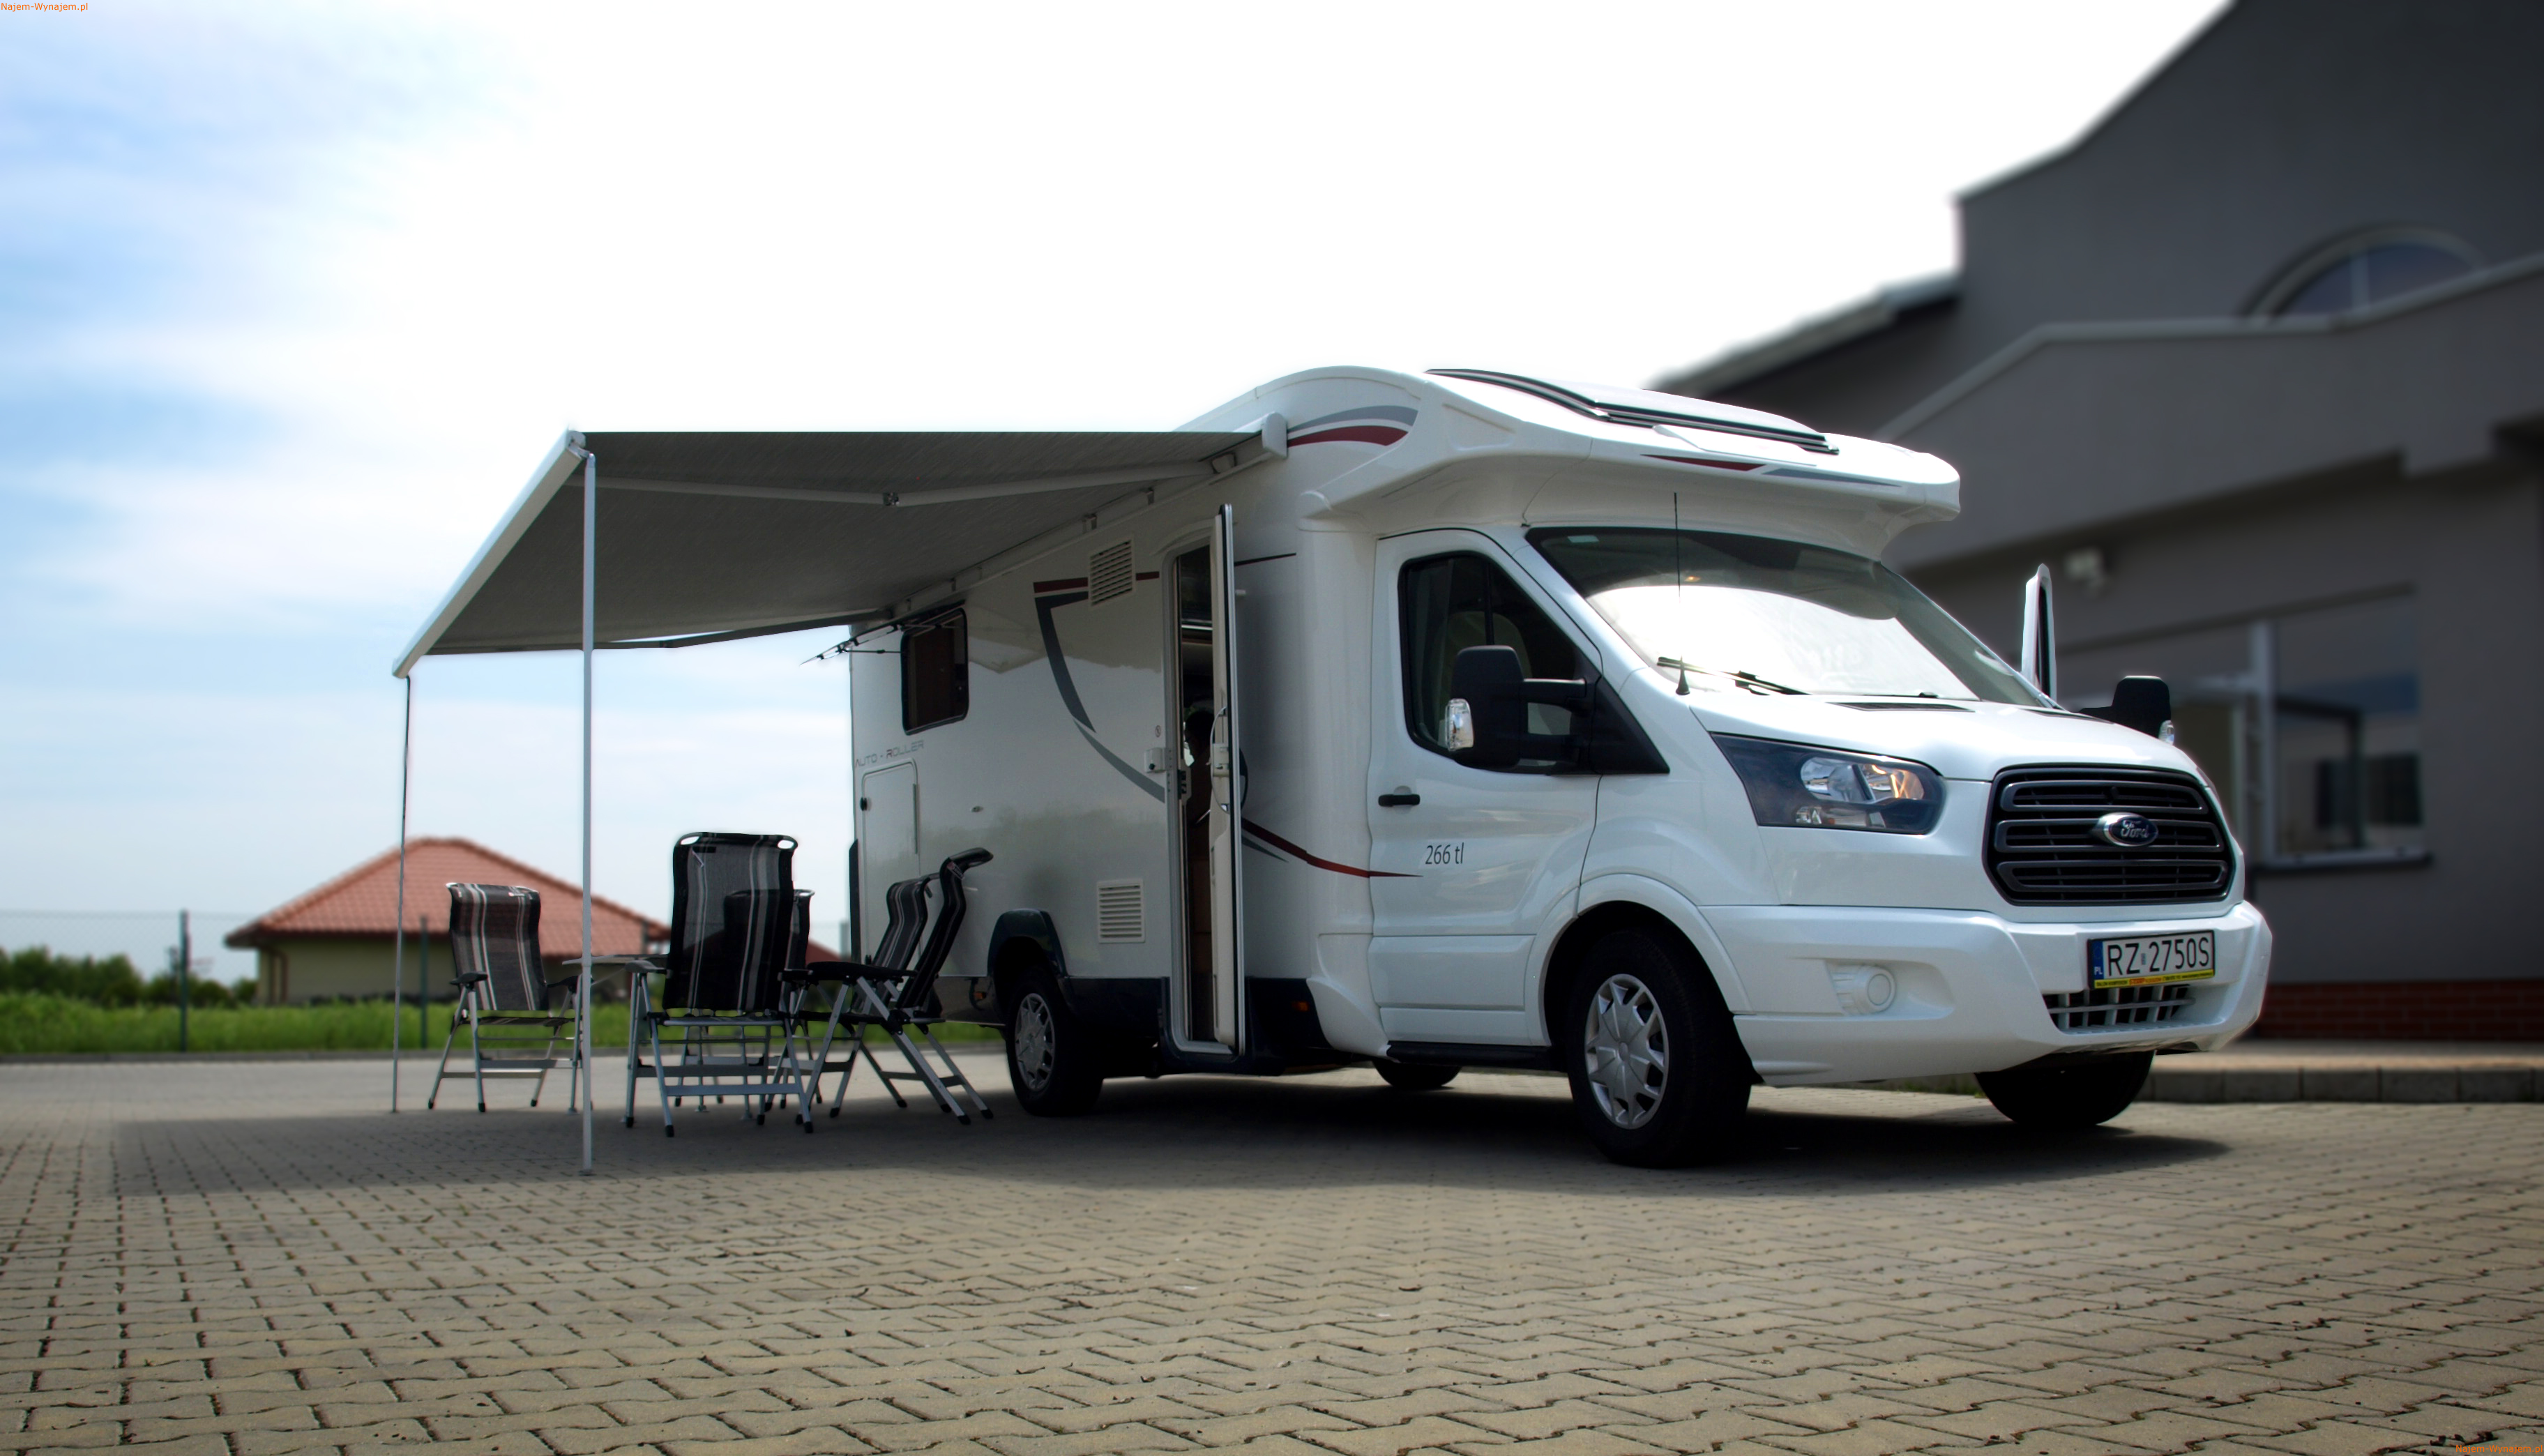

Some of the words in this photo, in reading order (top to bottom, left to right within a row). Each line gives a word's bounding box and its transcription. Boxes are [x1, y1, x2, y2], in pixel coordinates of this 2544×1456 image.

[856, 753, 877, 767] AUTO
[886, 740, 925, 759] ROLLER
[2121, 819, 2149, 838] Ford
[1425, 844, 1451, 865] 266
[1455, 842, 1464, 865] tl
[2107, 943, 2140, 976] RZ
[2149, 936, 2209, 972] 2750S
[2094, 966, 2103, 976] PL
